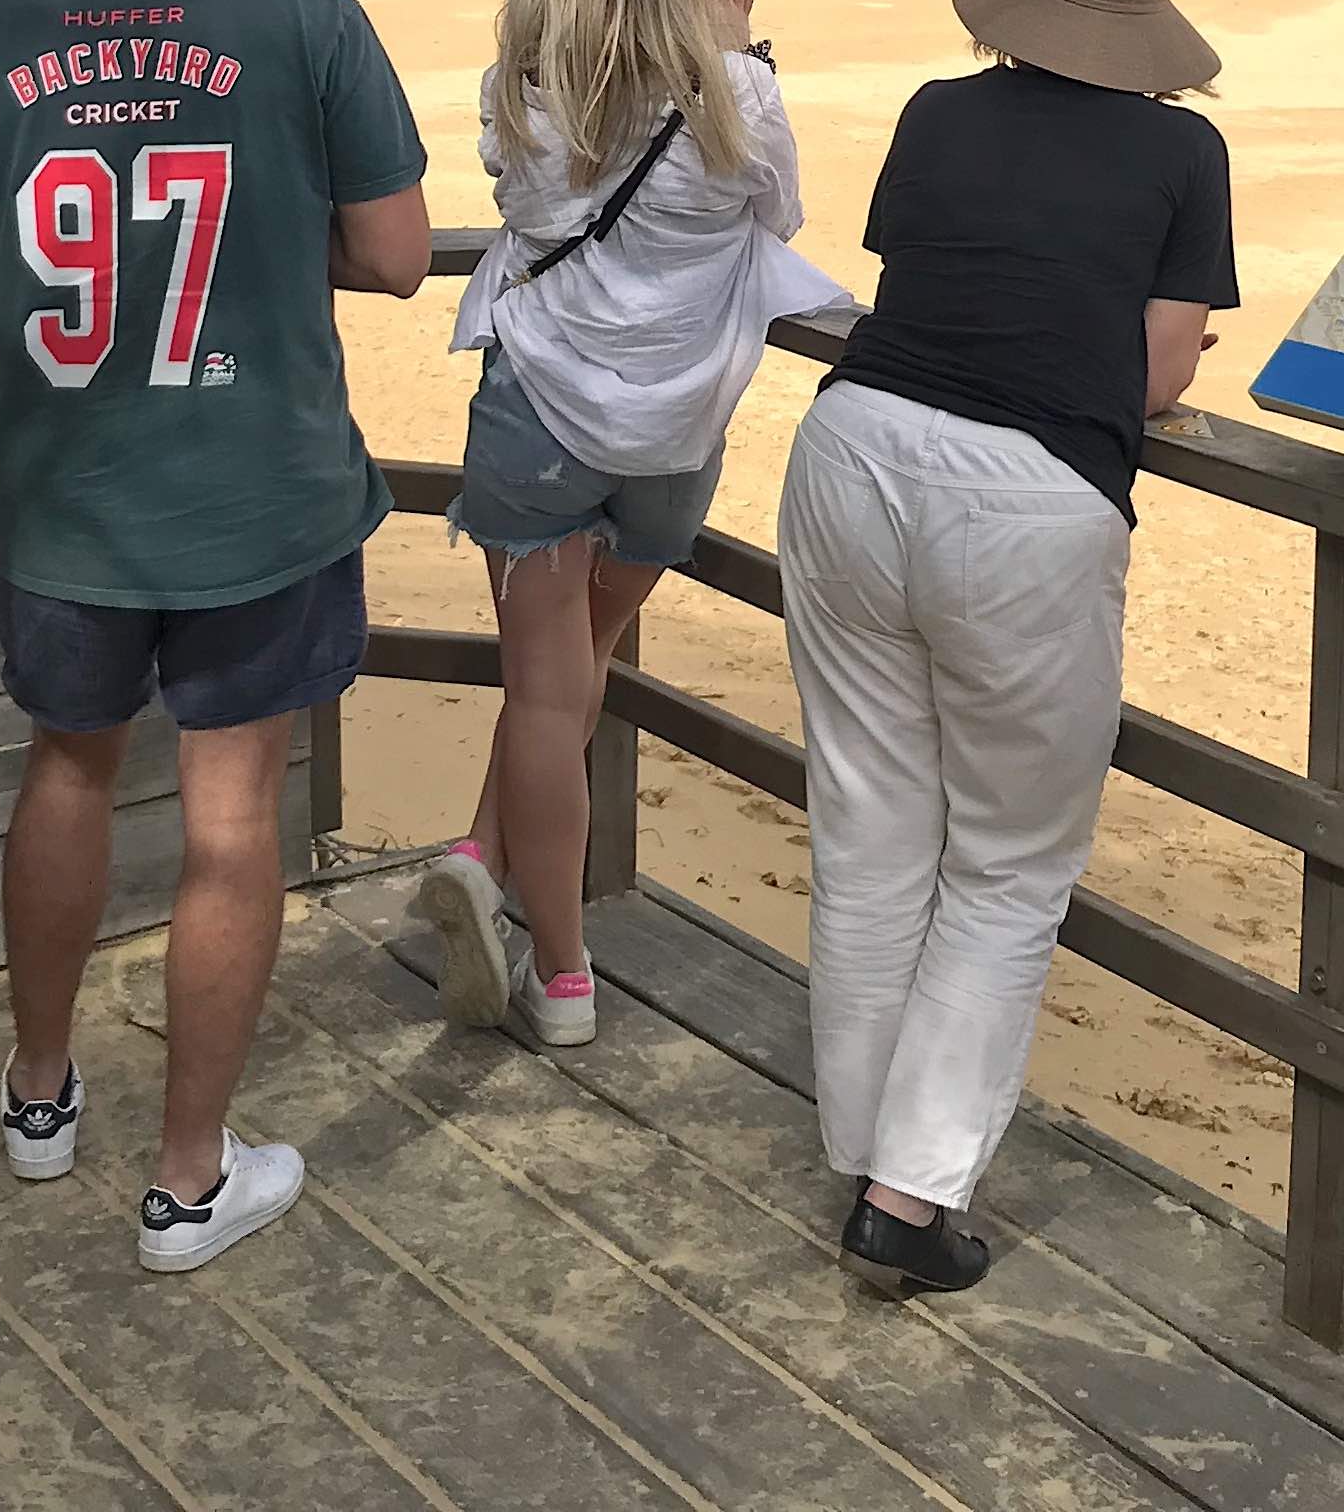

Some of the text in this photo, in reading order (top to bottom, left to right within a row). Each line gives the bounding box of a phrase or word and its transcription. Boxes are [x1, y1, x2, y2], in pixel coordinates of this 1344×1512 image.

[64, 7, 184, 27] HUFFER
[7, 38, 242, 108] BACKYARD
[66, 99, 180, 125] CRICKET
[15, 143, 233, 388] 97
